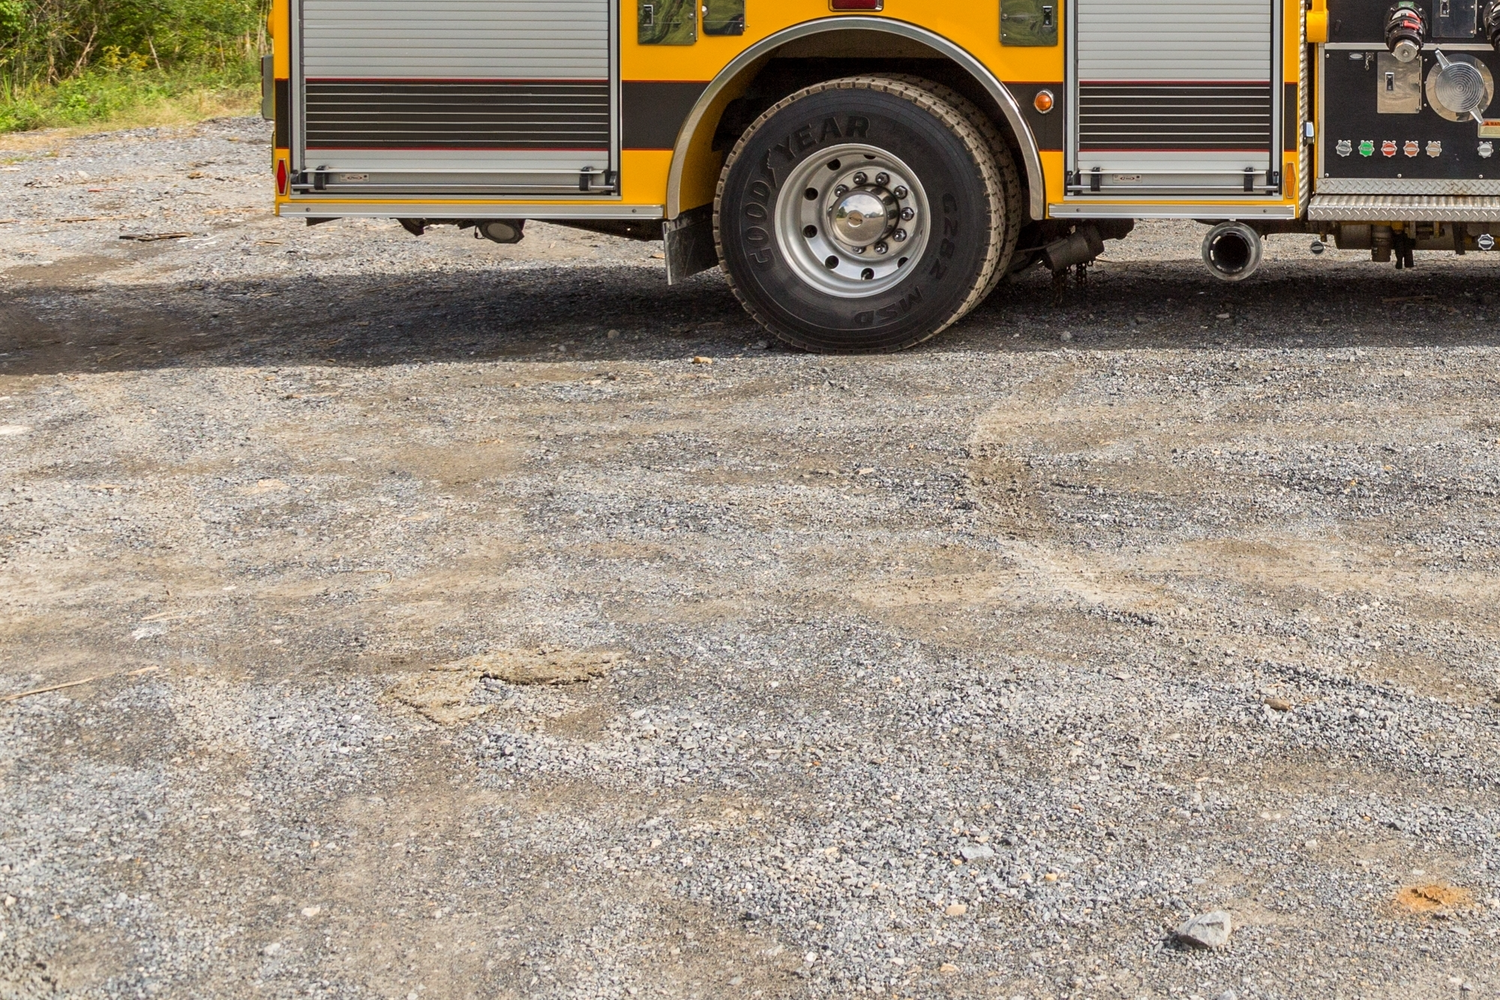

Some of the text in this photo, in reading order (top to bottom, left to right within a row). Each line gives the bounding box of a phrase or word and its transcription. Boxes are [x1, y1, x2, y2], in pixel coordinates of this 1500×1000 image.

[742, 115, 872, 268] GOODYEAR
[929, 192, 958, 281] G282
[853, 286, 924, 327] MSD
